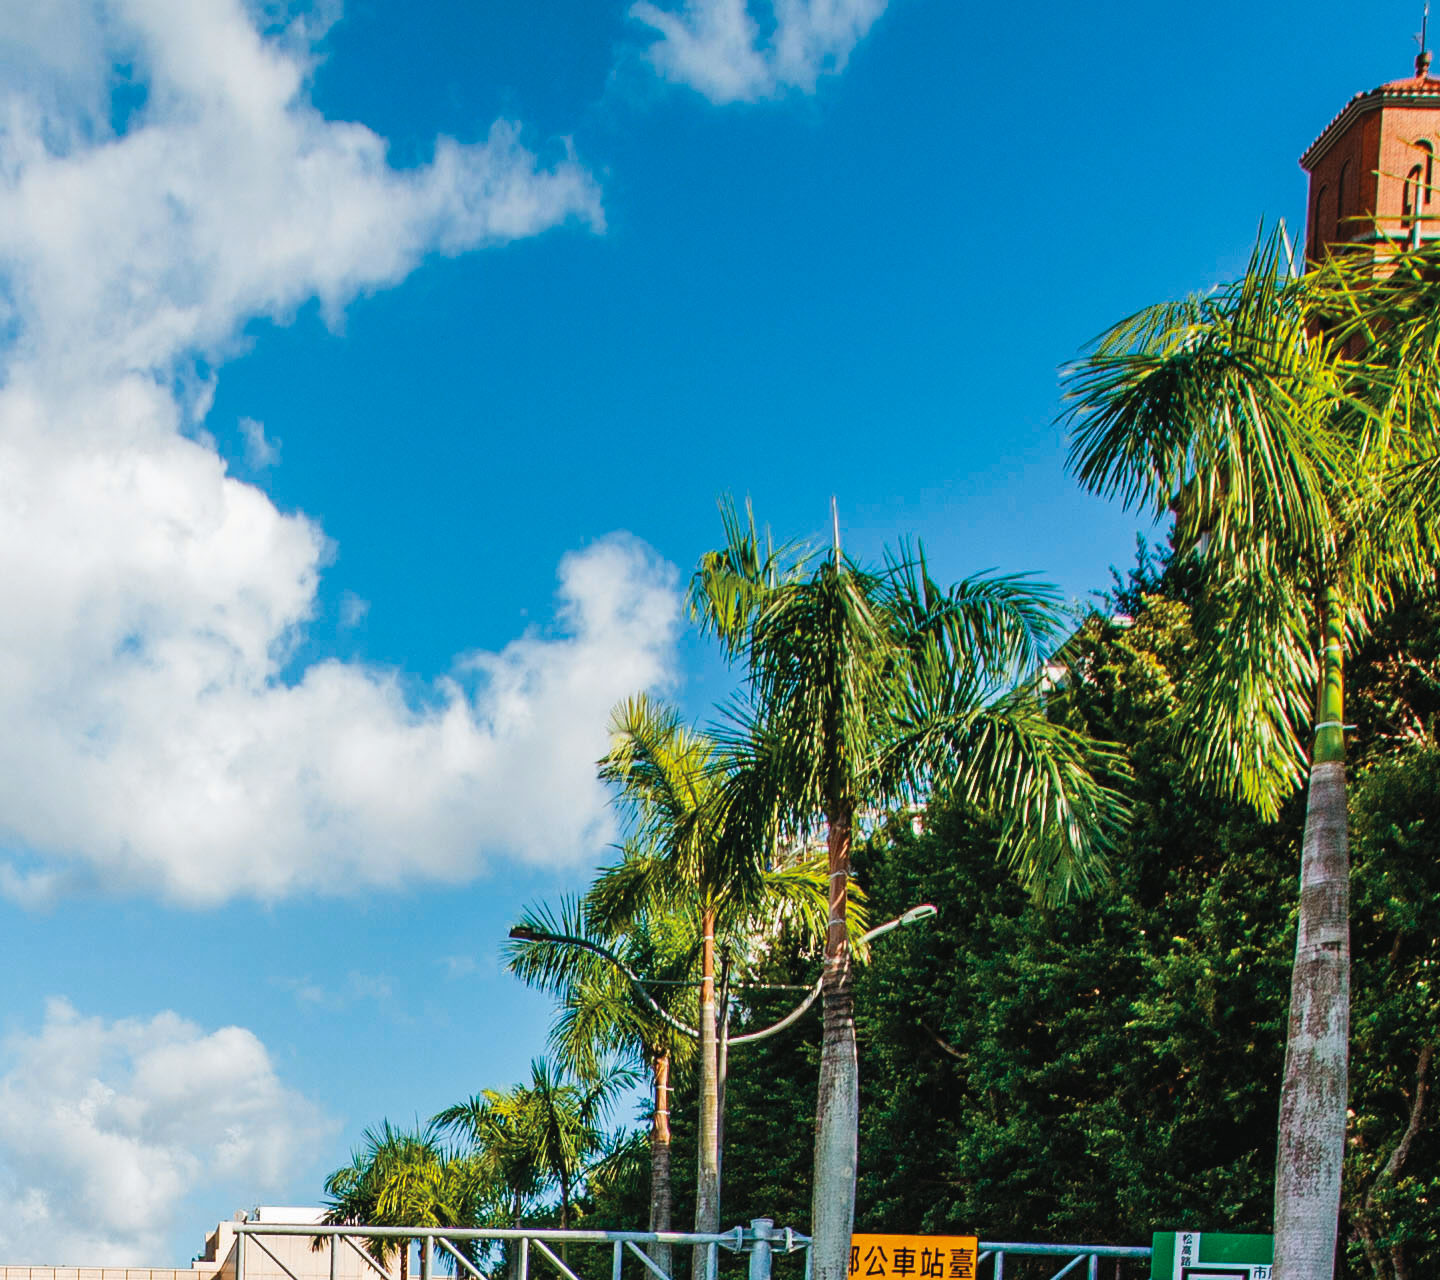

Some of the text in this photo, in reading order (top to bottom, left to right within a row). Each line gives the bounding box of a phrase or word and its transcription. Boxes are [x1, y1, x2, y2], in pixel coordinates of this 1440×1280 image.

[1181, 1234, 1193, 1267] 松高路
[1253, 1266, 1273, 1280] 市
